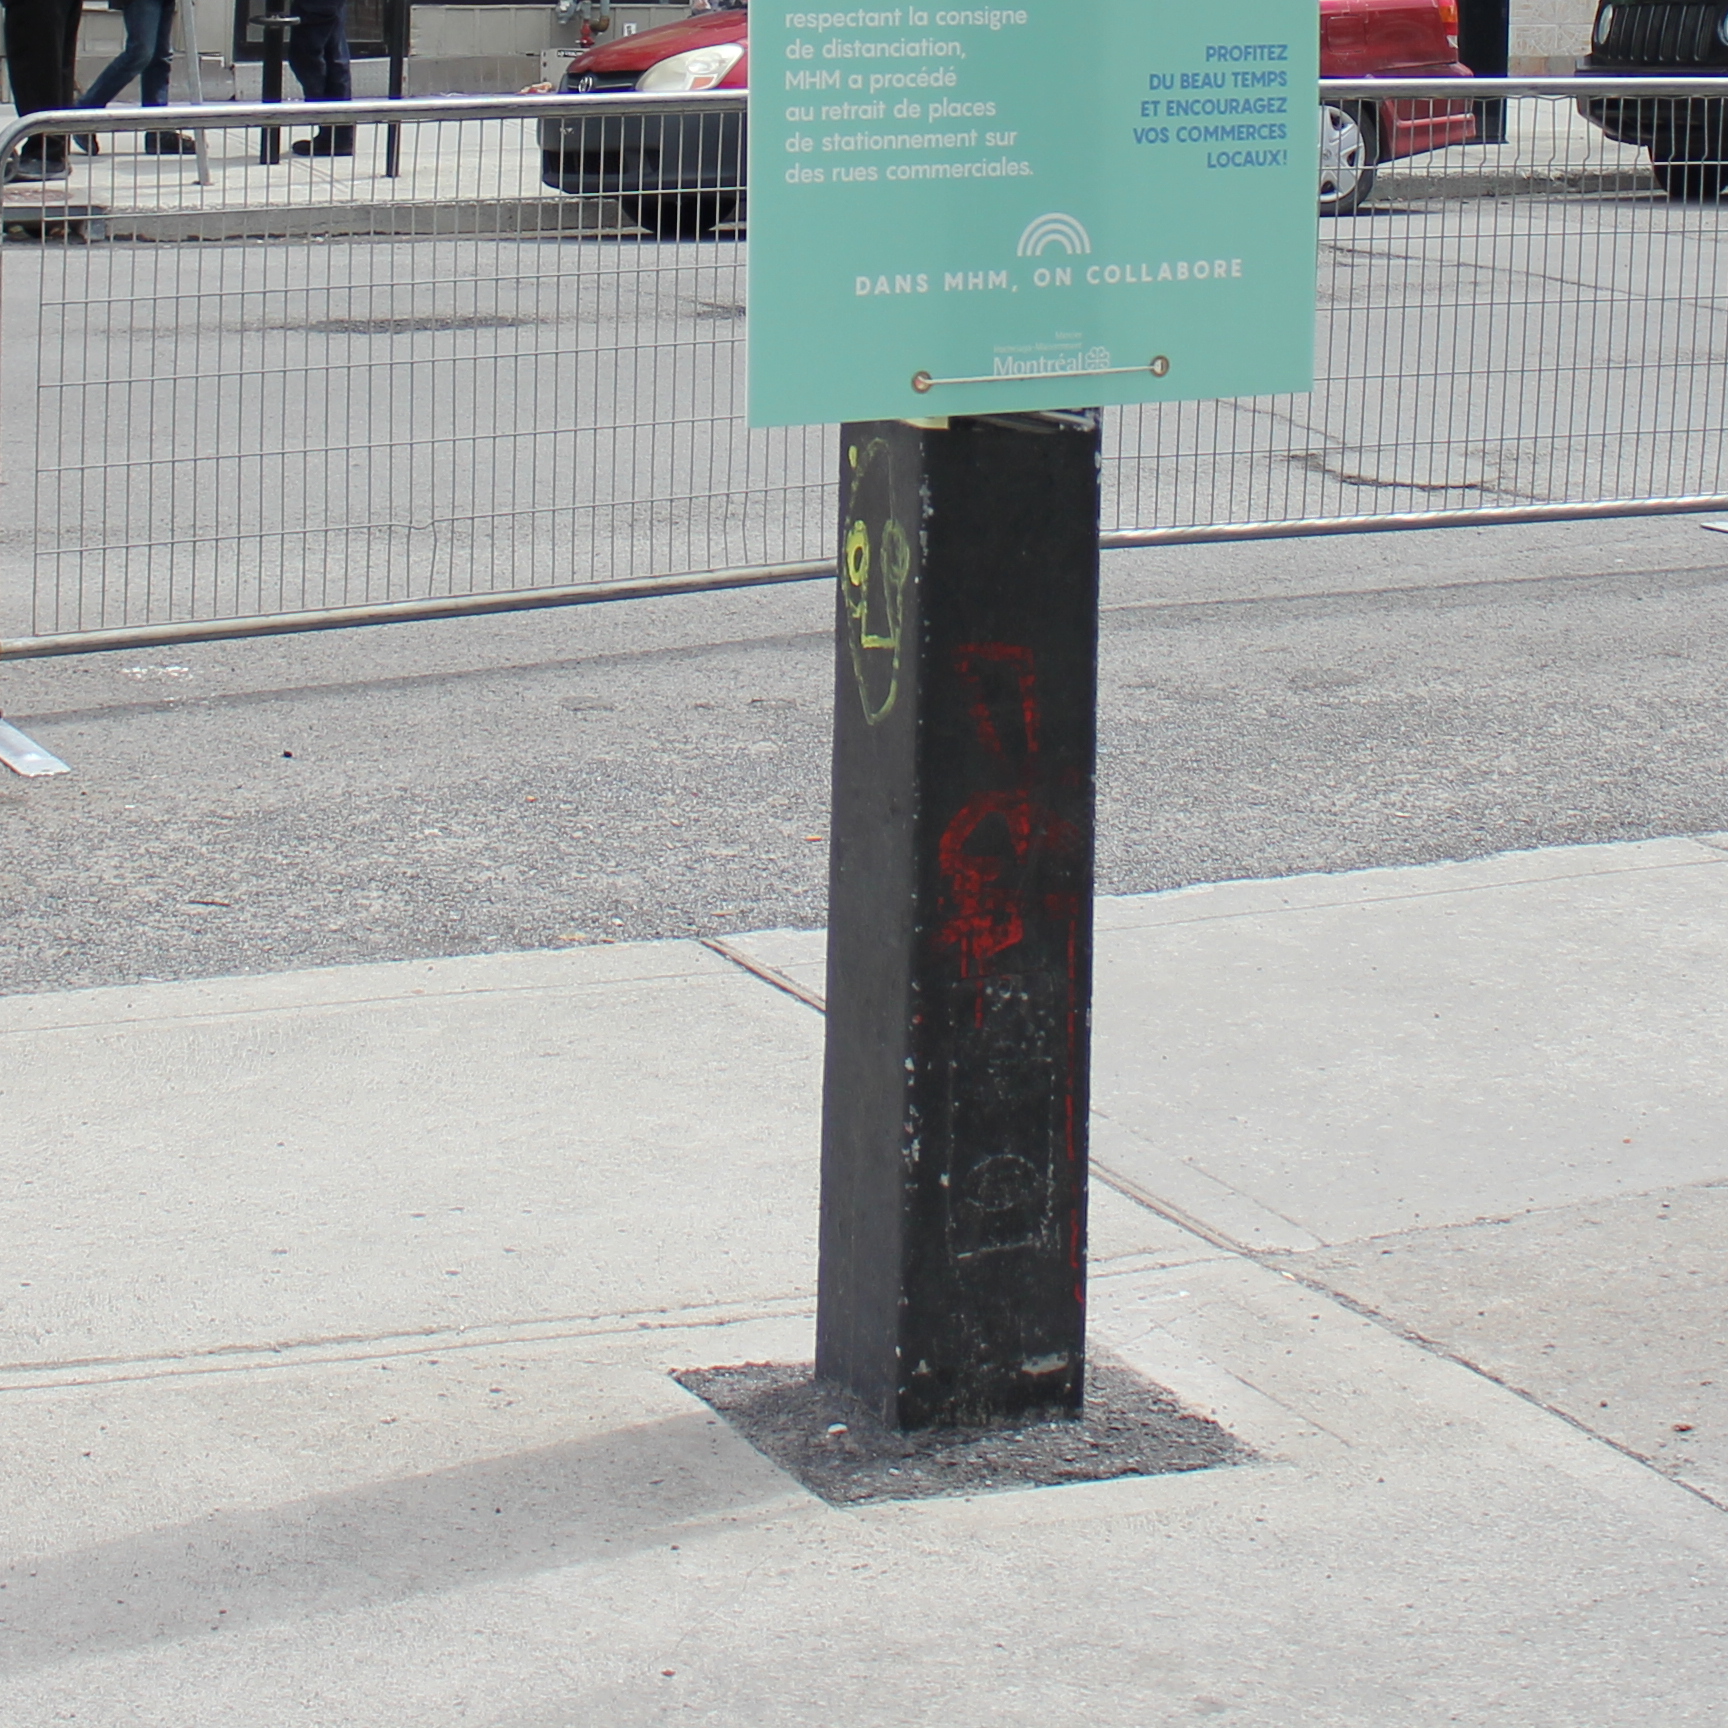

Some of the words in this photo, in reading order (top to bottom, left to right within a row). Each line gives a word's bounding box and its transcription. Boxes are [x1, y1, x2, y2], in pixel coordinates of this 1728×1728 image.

[786, 9, 902, 33] respectant
[909, 6, 928, 25] la
[936, 6, 1027, 30] consigne
[786, 39, 814, 59] de
[822, 38, 965, 59] distanciation,
[1206, 45, 1287, 62] PROFITEZ
[786, 70, 839, 90] MHM
[848, 75, 862, 88] a
[870, 66, 956, 94] procédé
[1150, 74, 1174, 90] DU
[1181, 73, 1225, 89] BEAU
[1232, 71, 1287, 87] TEMPS
[786, 107, 813, 121] au
[822, 100, 885, 120] retrait
[894, 98, 920, 118] de
[929, 97, 995, 123] places
[1141, 100, 1160, 117] ET
[1167, 97, 1287, 116] ENCOURAGEZ
[786, 132, 813, 152] de
[822, 129, 977, 151] stationnement
[986, 132, 1017, 146] sur
[1133, 127, 1169, 144] VOS
[1177, 124, 1286, 142] COMMERCES
[785, 163, 824, 183] des
[833, 167, 878, 181] rues
[886, 157, 1033, 180] commerciales.
[1207, 150, 1287, 168] LOCAUX!
[856, 274, 927, 295] DANS
[945, 270, 1017, 292] MHM,
[1034, 267, 1071, 286] ON
[1087, 259, 1241, 284] COLLABORE
[993, 353, 1083, 376] Montréal
